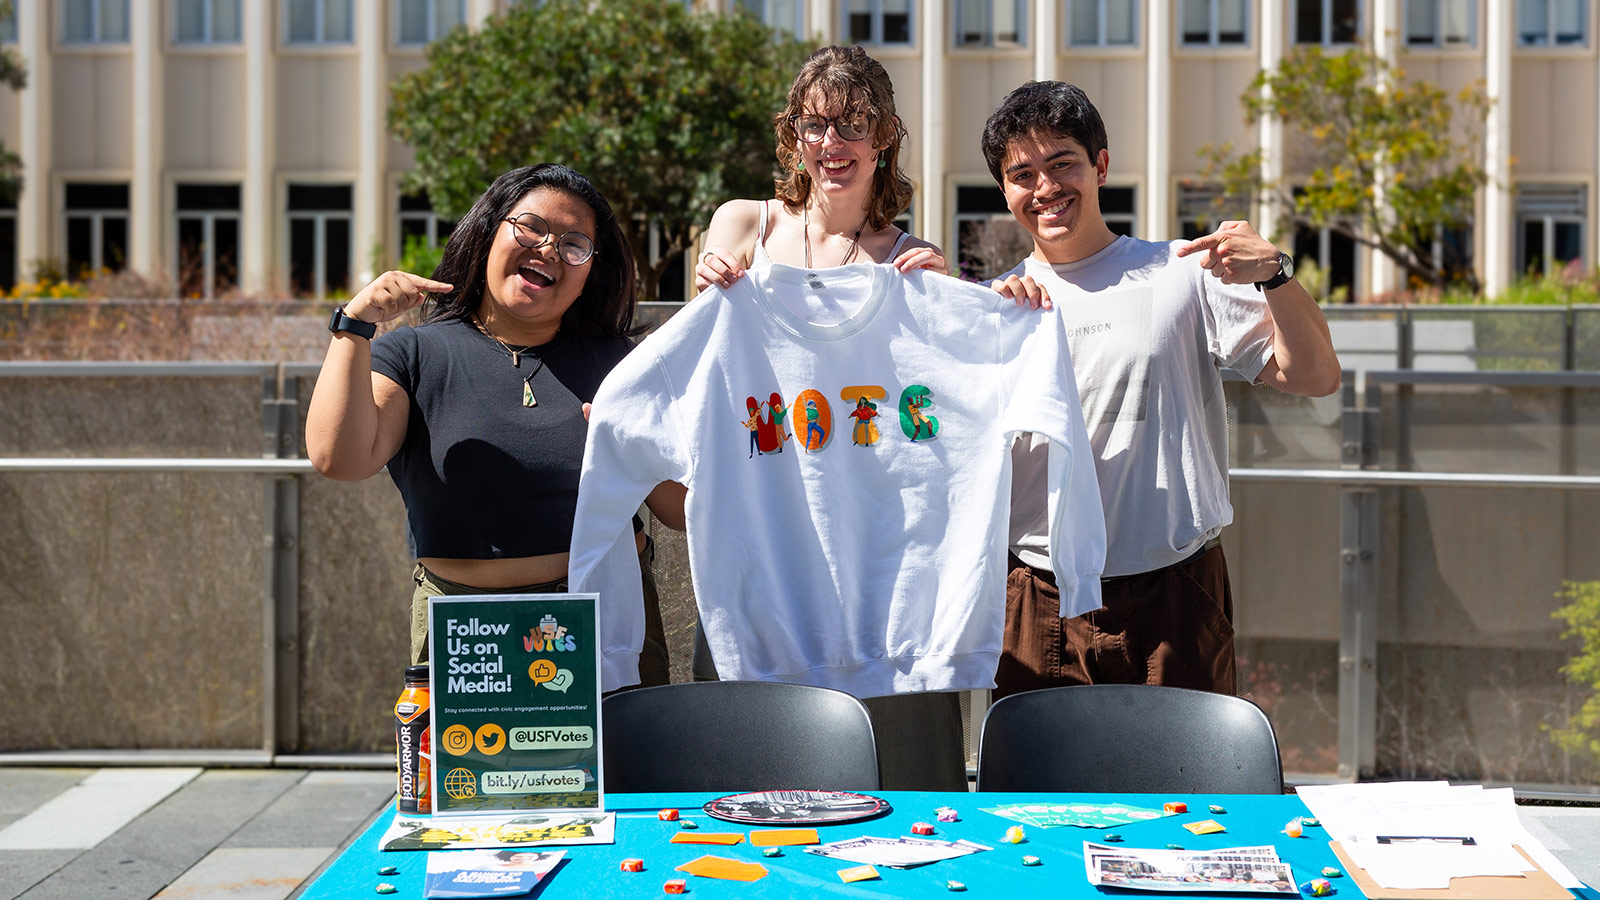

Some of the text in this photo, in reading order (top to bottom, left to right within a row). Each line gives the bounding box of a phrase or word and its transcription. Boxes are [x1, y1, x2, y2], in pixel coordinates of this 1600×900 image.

[1067, 322, 1111, 338] OHNSON
[745, 384, 940, 453] VOTE
[447, 618, 510, 636] Follow
[529, 624, 567, 640] USF
[447, 638, 498, 655] Us on
[523, 634, 577, 652] VOTES
[447, 655, 503, 674] Social
[447, 674, 512, 693] Media!
[515, 730, 588, 743] @USFVotes
[401, 726, 413, 799] BODYARMOR
[487, 774, 580, 790] bit.ly/usfvotes
